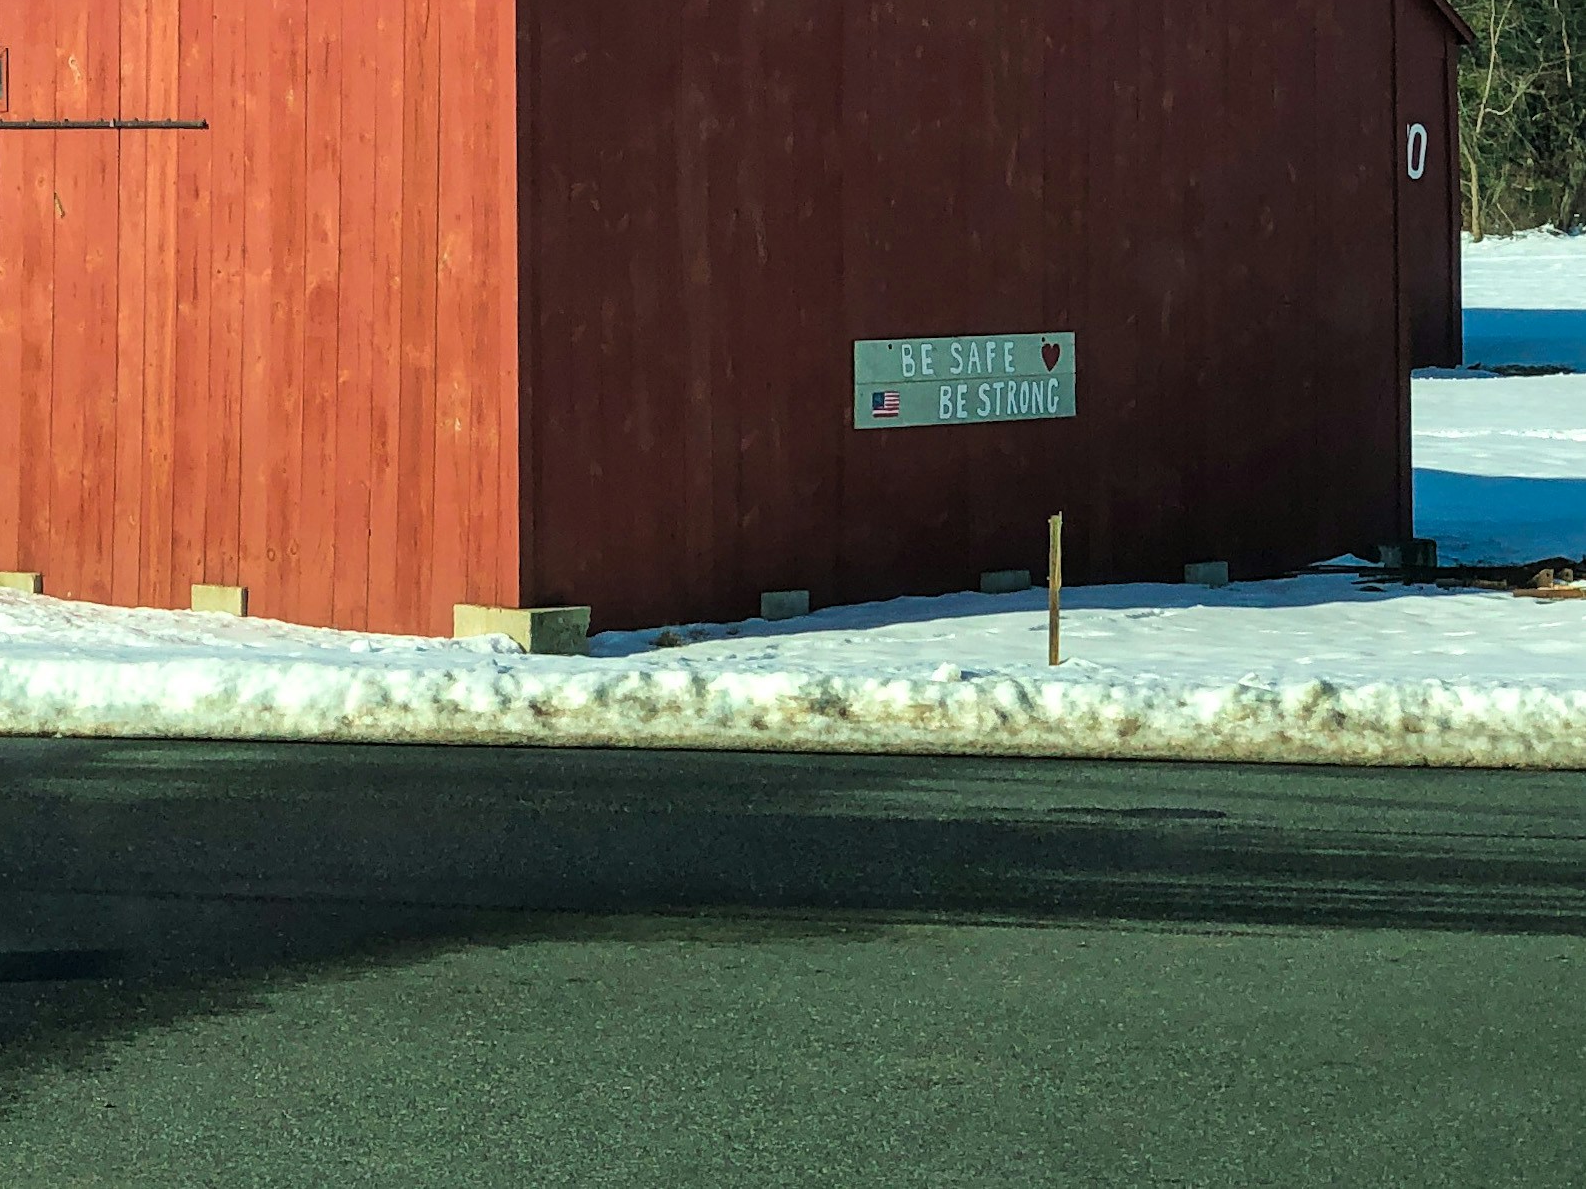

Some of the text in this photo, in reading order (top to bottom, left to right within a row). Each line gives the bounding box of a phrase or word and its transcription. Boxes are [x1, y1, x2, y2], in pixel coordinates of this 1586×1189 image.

[901, 341, 1015, 377] BE SAFE
[938, 377, 1060, 420] BE STRONG
